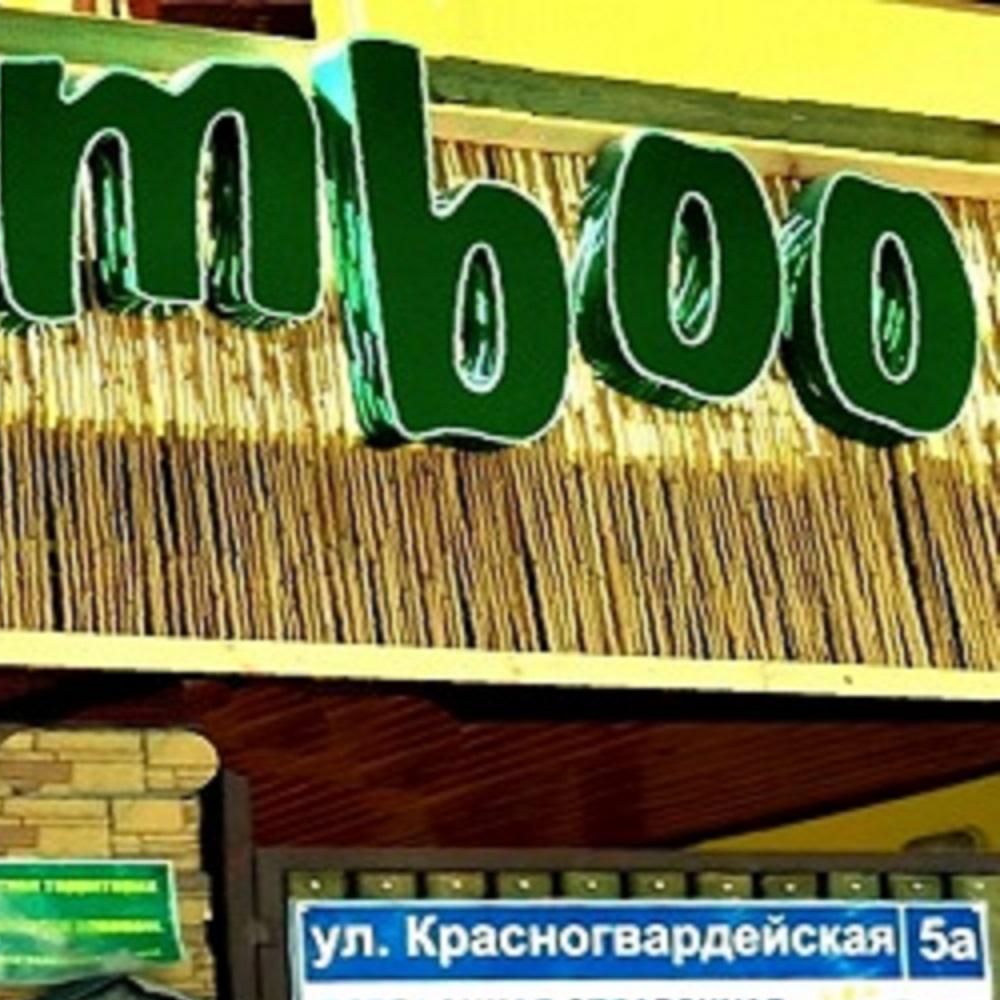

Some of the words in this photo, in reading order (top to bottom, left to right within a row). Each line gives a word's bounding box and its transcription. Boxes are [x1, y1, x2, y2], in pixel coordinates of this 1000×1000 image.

[309, 922, 391, 970] ул.
[405, 913, 897, 969] Красногвардейская
[919, 916, 979, 962] 5а
